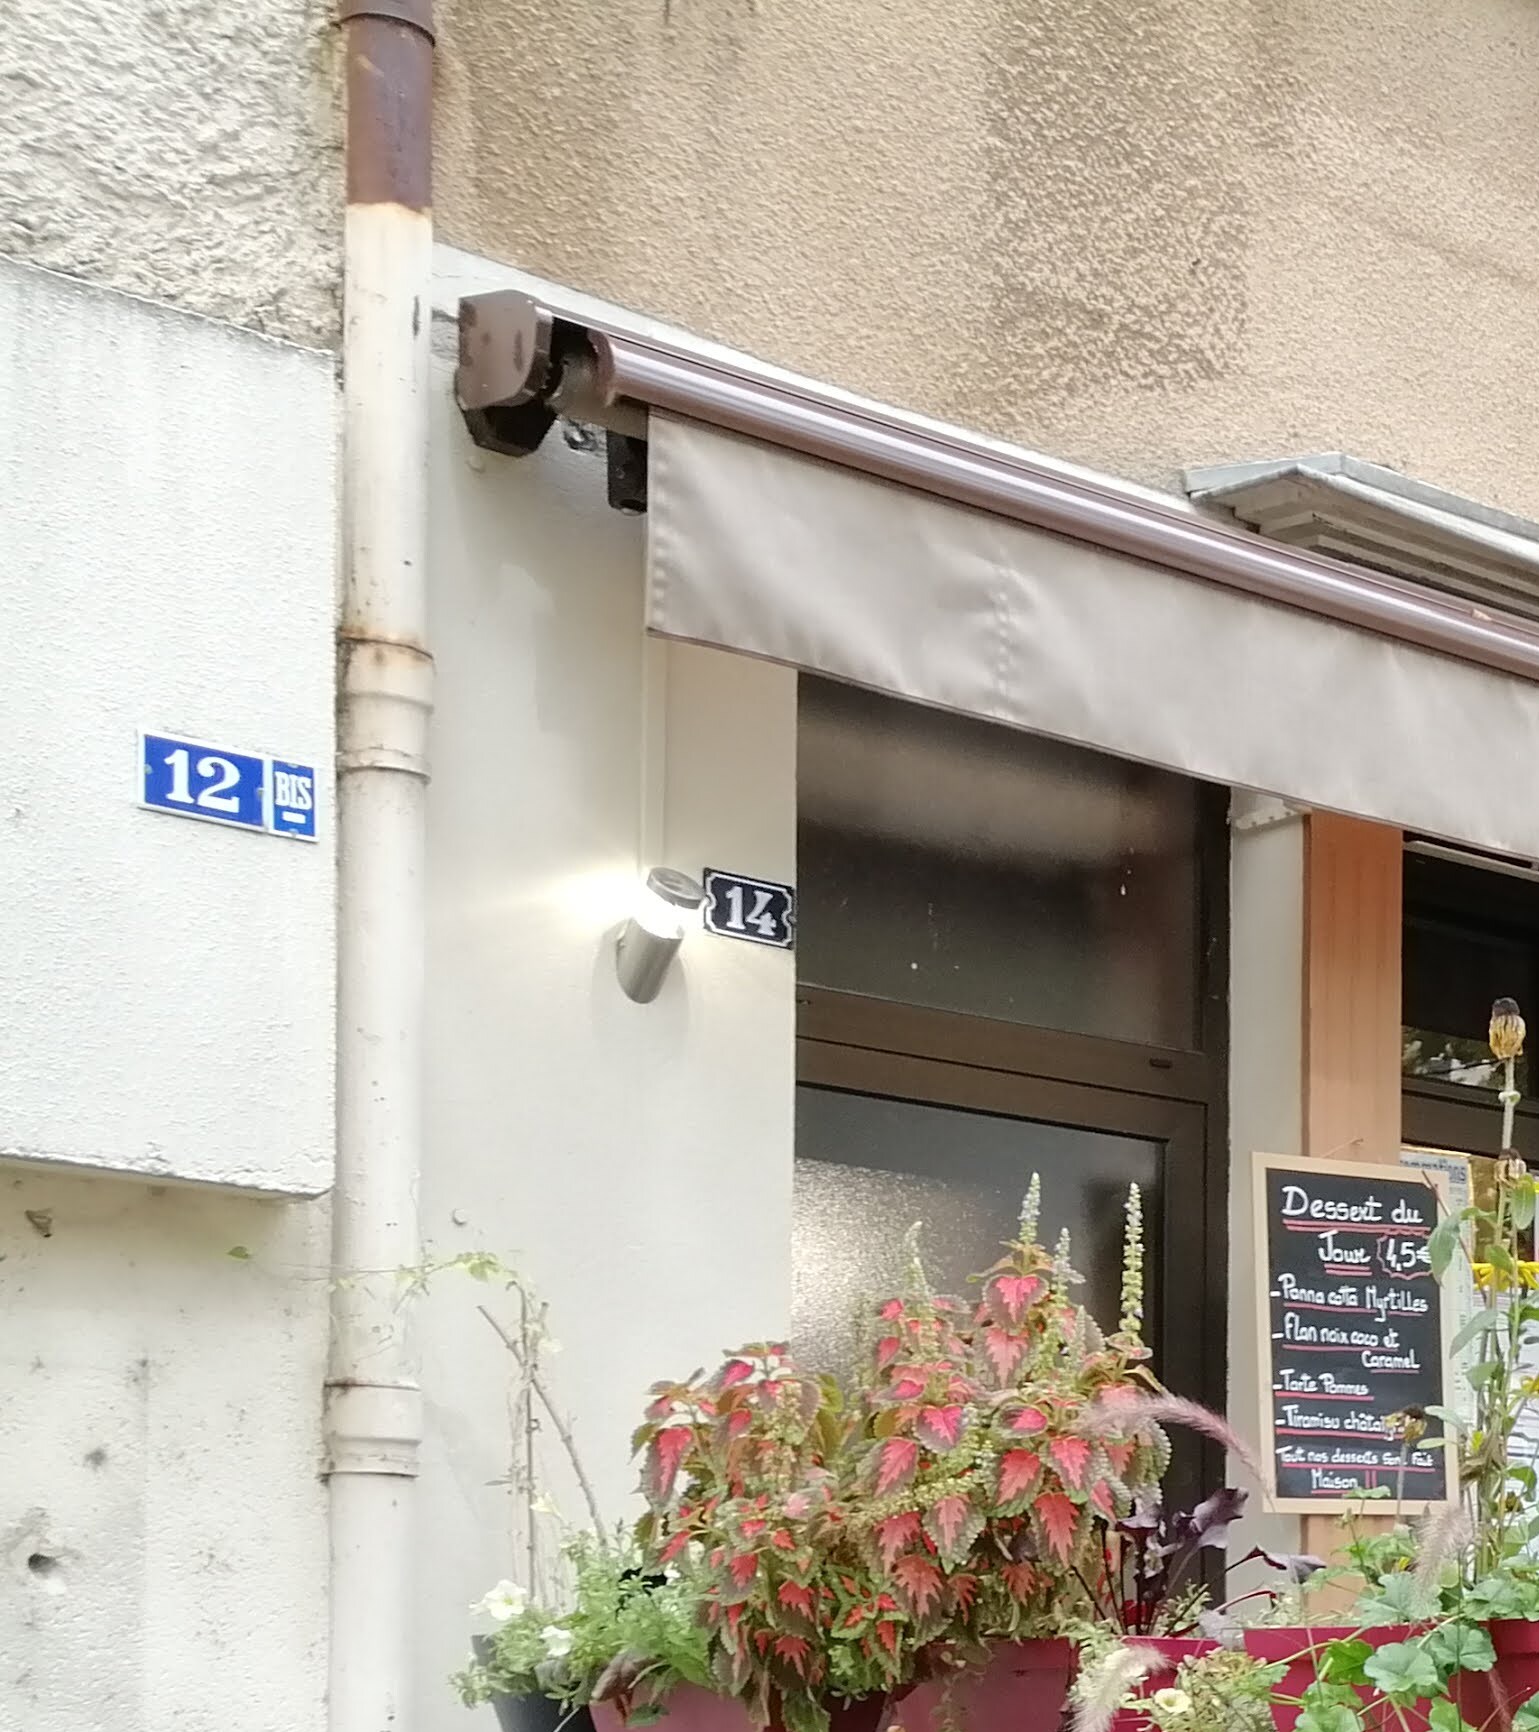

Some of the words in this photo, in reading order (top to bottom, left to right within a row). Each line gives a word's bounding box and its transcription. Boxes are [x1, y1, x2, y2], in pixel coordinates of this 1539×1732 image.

[163, 749, 241, 813] 12
[274, 771, 312, 810] BIS
[725, 886, 777, 936] 14
[1281, 1185, 1382, 1221] Dessert
[1391, 1199, 1423, 1223] du
[1318, 1229, 1371, 1263] Jour
[1278, 1273, 1324, 1304] Panna
[1365, 1285, 1428, 1322] Myrtilles
[1351, 1331, 1379, 1346] coco
[1383, 1328, 1400, 1348] et
[1279, 1369, 1318, 1392] Tarte
[1311, 1469, 1359, 1489] Maison
